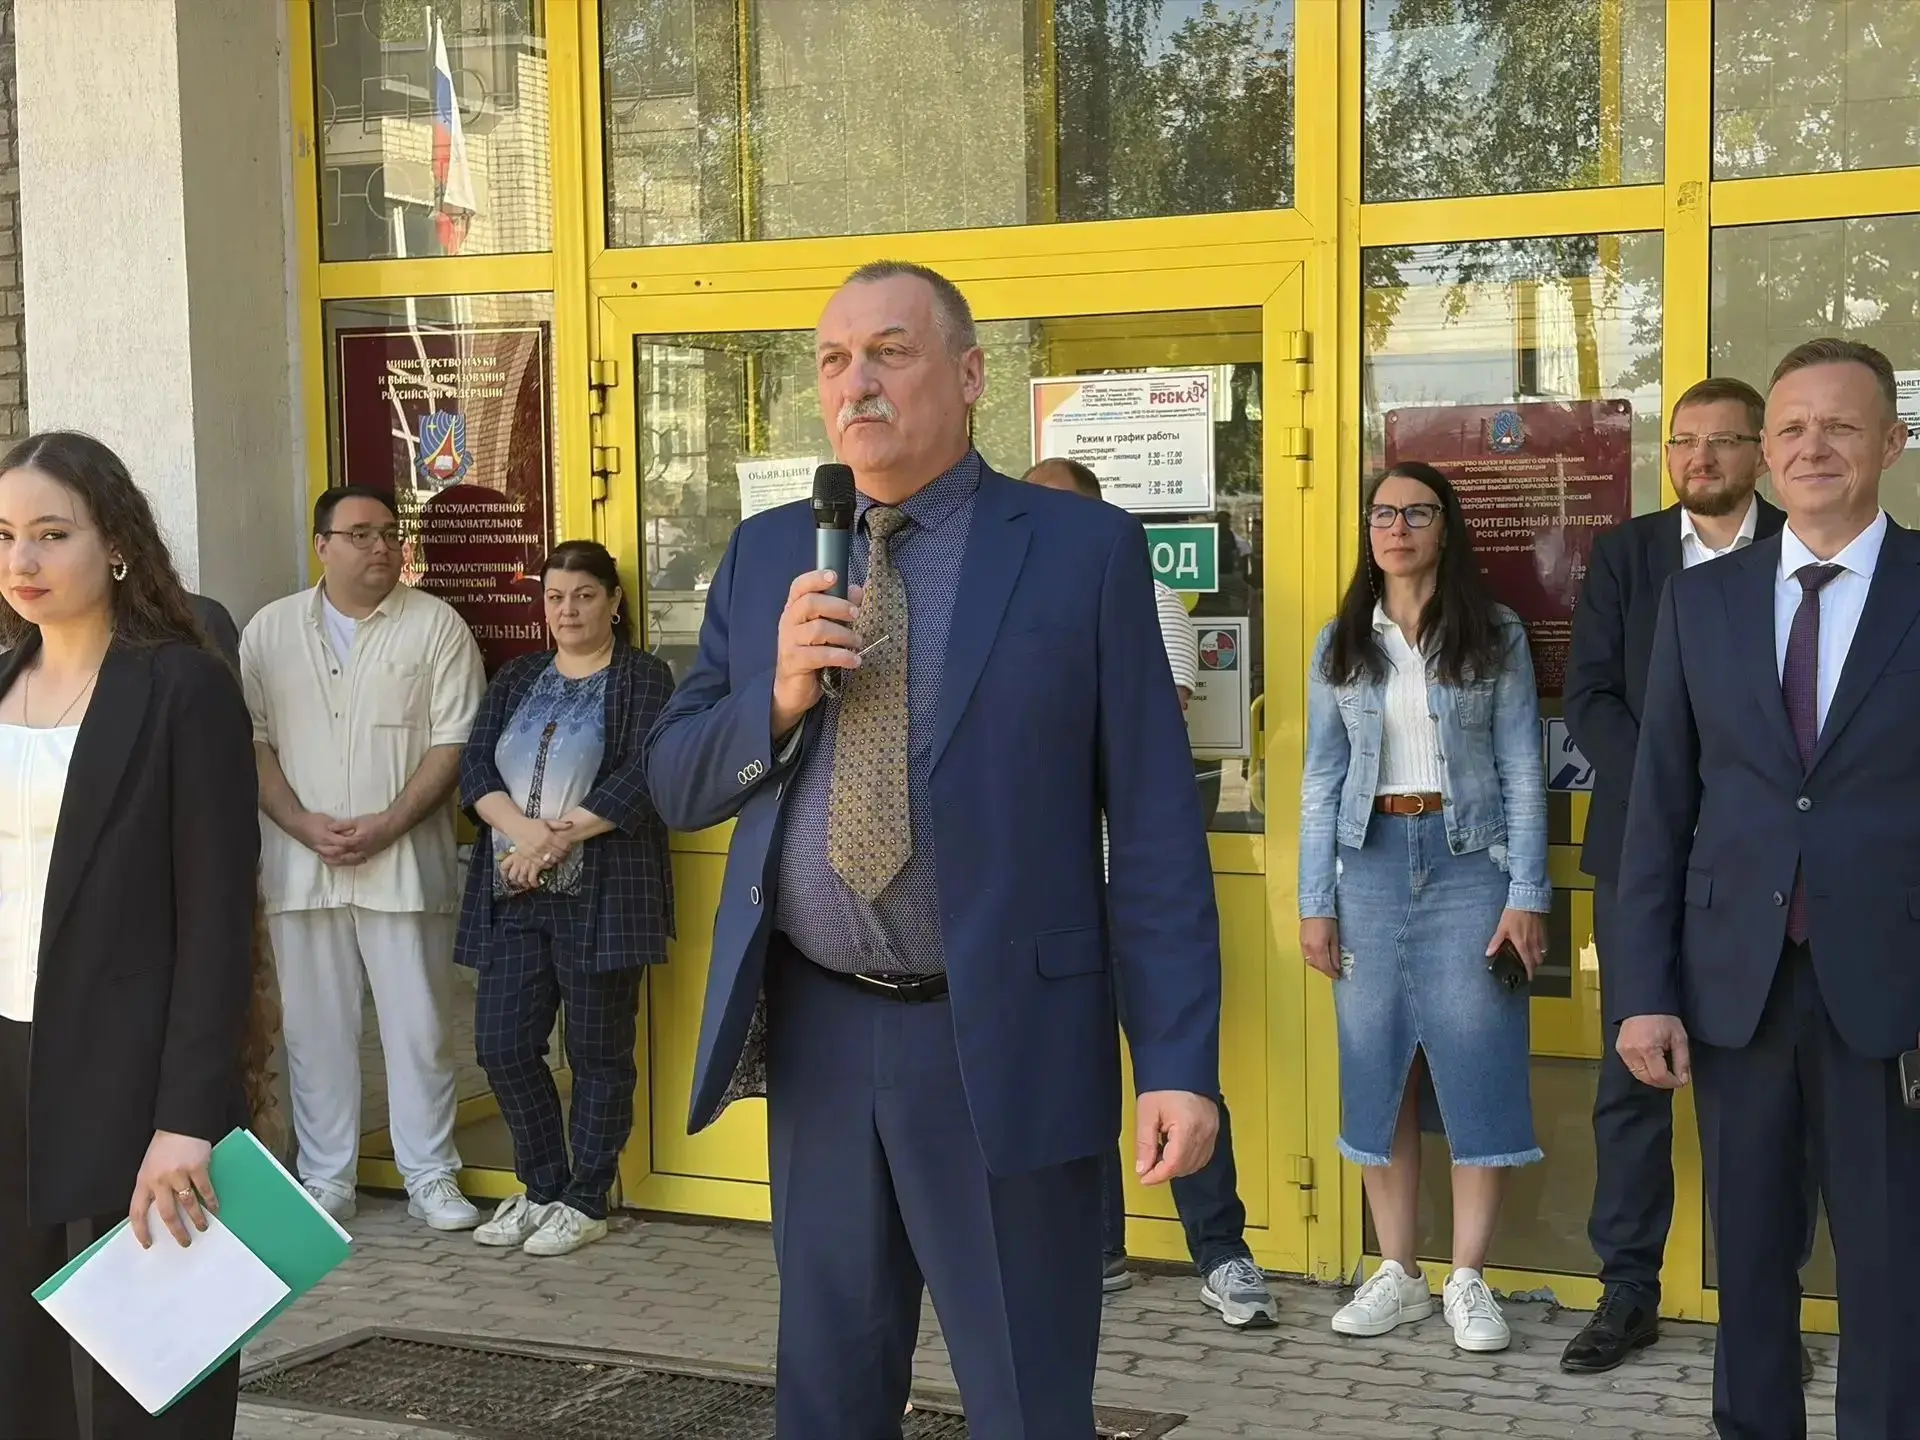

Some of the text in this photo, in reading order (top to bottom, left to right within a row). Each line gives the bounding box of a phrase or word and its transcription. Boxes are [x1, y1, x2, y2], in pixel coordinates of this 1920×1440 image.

[387, 357, 497, 369] МИНИСТЕРСТВО НАУКИ
[378, 375, 385, 385] И
[436, 372, 505, 383] ОБРАЗОВАНИЯ
[382, 387, 503, 400] РОССИЙСКОЙ ФЕДЕРАЦИИ
[1149, 391, 1185, 404] РССК
[1076, 434, 1105, 444] Режим
[1114, 432, 1145, 444] график
[1147, 431, 1180, 442] работы
[1464, 465, 1508, 473] РОССИЙСКОЙ
[1461, 495, 1524, 504] ГОСУДАРСТВЕННЫЙ
[435, 503, 525, 514] ГОСУДАРСТВЕННОЕ
[431, 518, 523, 529] ОБРАЗОВАТЕЛЬНОЕ
[1552, 514, 1613, 527] КОЛЛЕДЖ
[420, 534, 467, 544] ВЫСШЕГО
[468, 534, 539, 544] ОБРАЗОВАНИЯ
[1475, 529, 1535, 538] РССК «РГРТУ»
[431, 561, 524, 574] ГОСУДАРСТВЕННЫЙ
[488, 593, 533, 604] УТКИНА»
